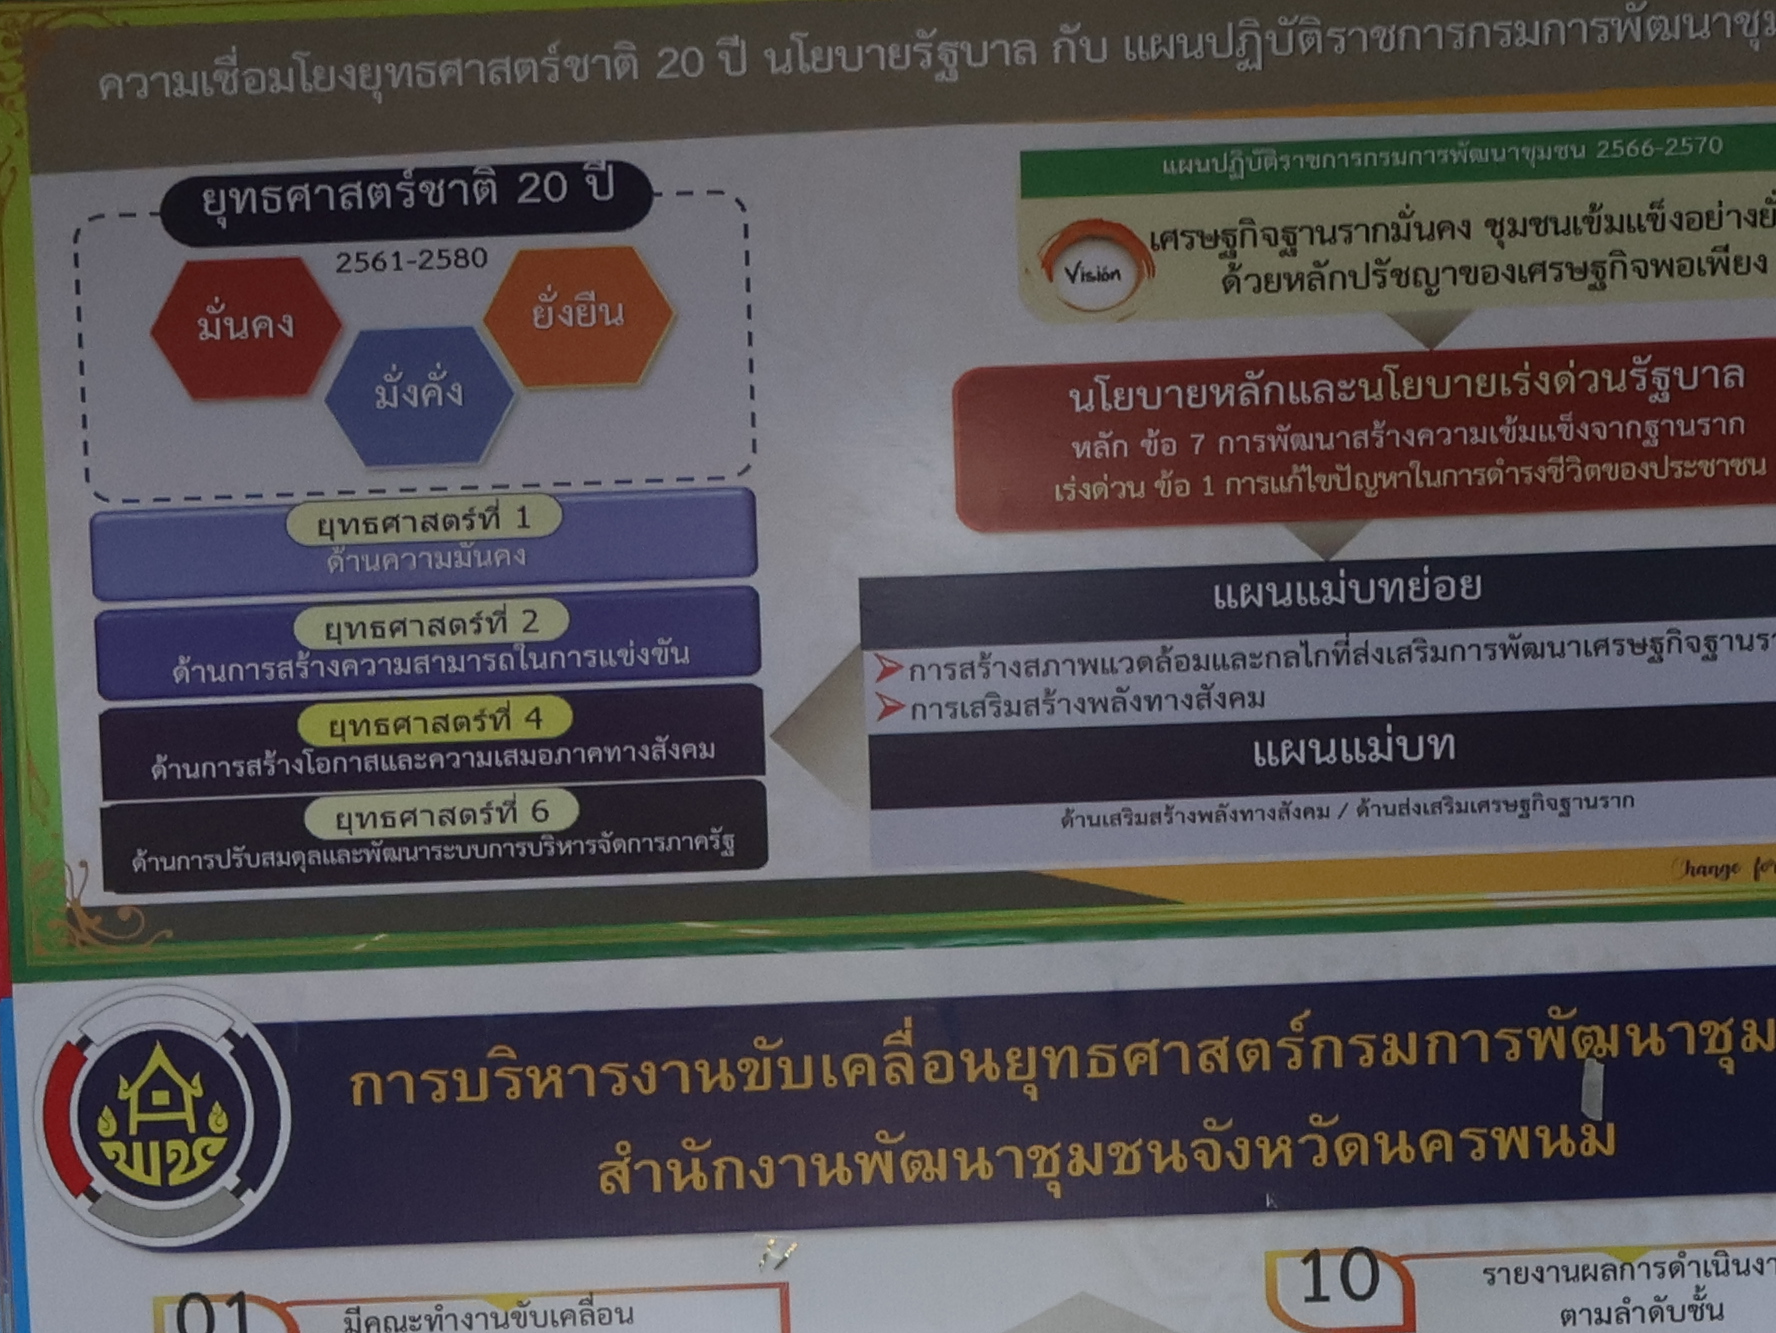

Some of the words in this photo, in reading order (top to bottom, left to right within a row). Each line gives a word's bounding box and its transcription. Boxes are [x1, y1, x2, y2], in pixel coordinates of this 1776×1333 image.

[99, 38, 640, 104] ความเชื่อมโยงยุทธศาสตร์ชาติ
[657, 45, 705, 80] 20
[718, 37, 747, 77] ปี
[765, 28, 1039, 83] นโยบายรัฐบาล
[1050, 22, 1106, 65] กับ
[1596, 135, 1724, 160] 2566-2570
[202, 164, 498, 229] ยุทธศาสตร์ชาติ
[517, 169, 570, 204] 20
[584, 159, 616, 202] ปี
[1149, 205, 1472, 263] เศรษฐกิจฐานรากมั่นคง
[335, 245, 489, 274] 2561-2580
[1220, 247, 1770, 298] ด้วยหลักปรัชญาของเศรษฐกิจพอเพียง
[196, 297, 296, 341] มั่นคง
[530, 285, 626, 330] ยั่งยืน
[373, 362, 465, 410] มั่งคั่ง
[1068, 357, 1747, 420] นโยบายหลักและนโยบายเร่งด่วนรัฐบาล
[1070, 430, 1130, 462] หลัก
[1139, 428, 1180, 458] ข้อ
[1189, 433, 1207, 457] 7
[1218, 405, 1747, 458] การพัฒนาสร้างความเข้มแข็งจากฐานราก
[1053, 469, 1145, 504] เร่งด่วน
[1153, 468, 1193, 501] ข้อ
[1201, 475, 1215, 498] 1
[317, 499, 506, 540] ยุทธศาสตร์ที่
[515, 504, 531, 530] 1
[1212, 564, 1484, 613] แผนแม่บทย่อย
[324, 600, 510, 646] ยุทธศาสตร์ที่
[521, 608, 540, 635] 2
[328, 698, 515, 742] ยุทธศาสตร์ที่
[524, 706, 545, 732] 4
[909, 684, 1267, 726] การเสริมสร้างพลังทางสังคม
[1251, 722, 1457, 770] แผนแม่บท
[335, 794, 520, 836] ยุทธศาสตร์ที่
[531, 797, 550, 825] 6
[1301, 1245, 1380, 1303] 10
[1559, 1285, 1726, 1327] ตามลำดับชั้น
